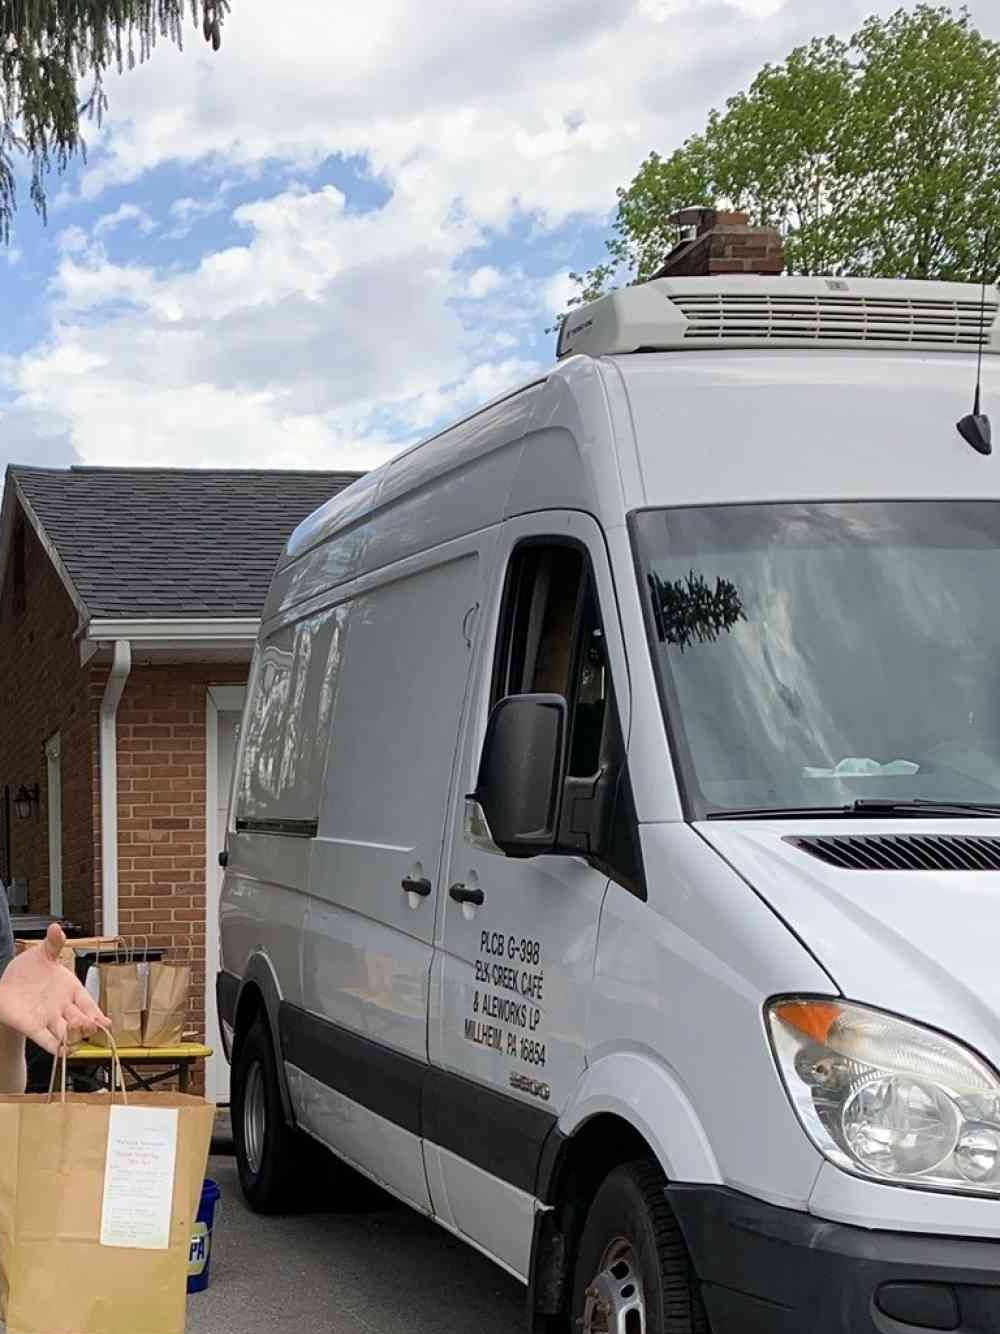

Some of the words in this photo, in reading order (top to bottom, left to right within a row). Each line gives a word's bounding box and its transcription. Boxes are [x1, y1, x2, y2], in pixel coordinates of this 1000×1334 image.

[481, 930, 504, 956] PLCB
[507, 935, 540, 966] G-398
[475, 959, 490, 984] ELK
[491, 963, 520, 993] CREEK
[520, 970, 544, 1000] CAFÉ
[482, 993, 527, 1028] ALEWORKS
[529, 1007, 540, 1031] LP
[506, 1032, 518, 1057] PA
[520, 1037, 546, 1068] 16854
